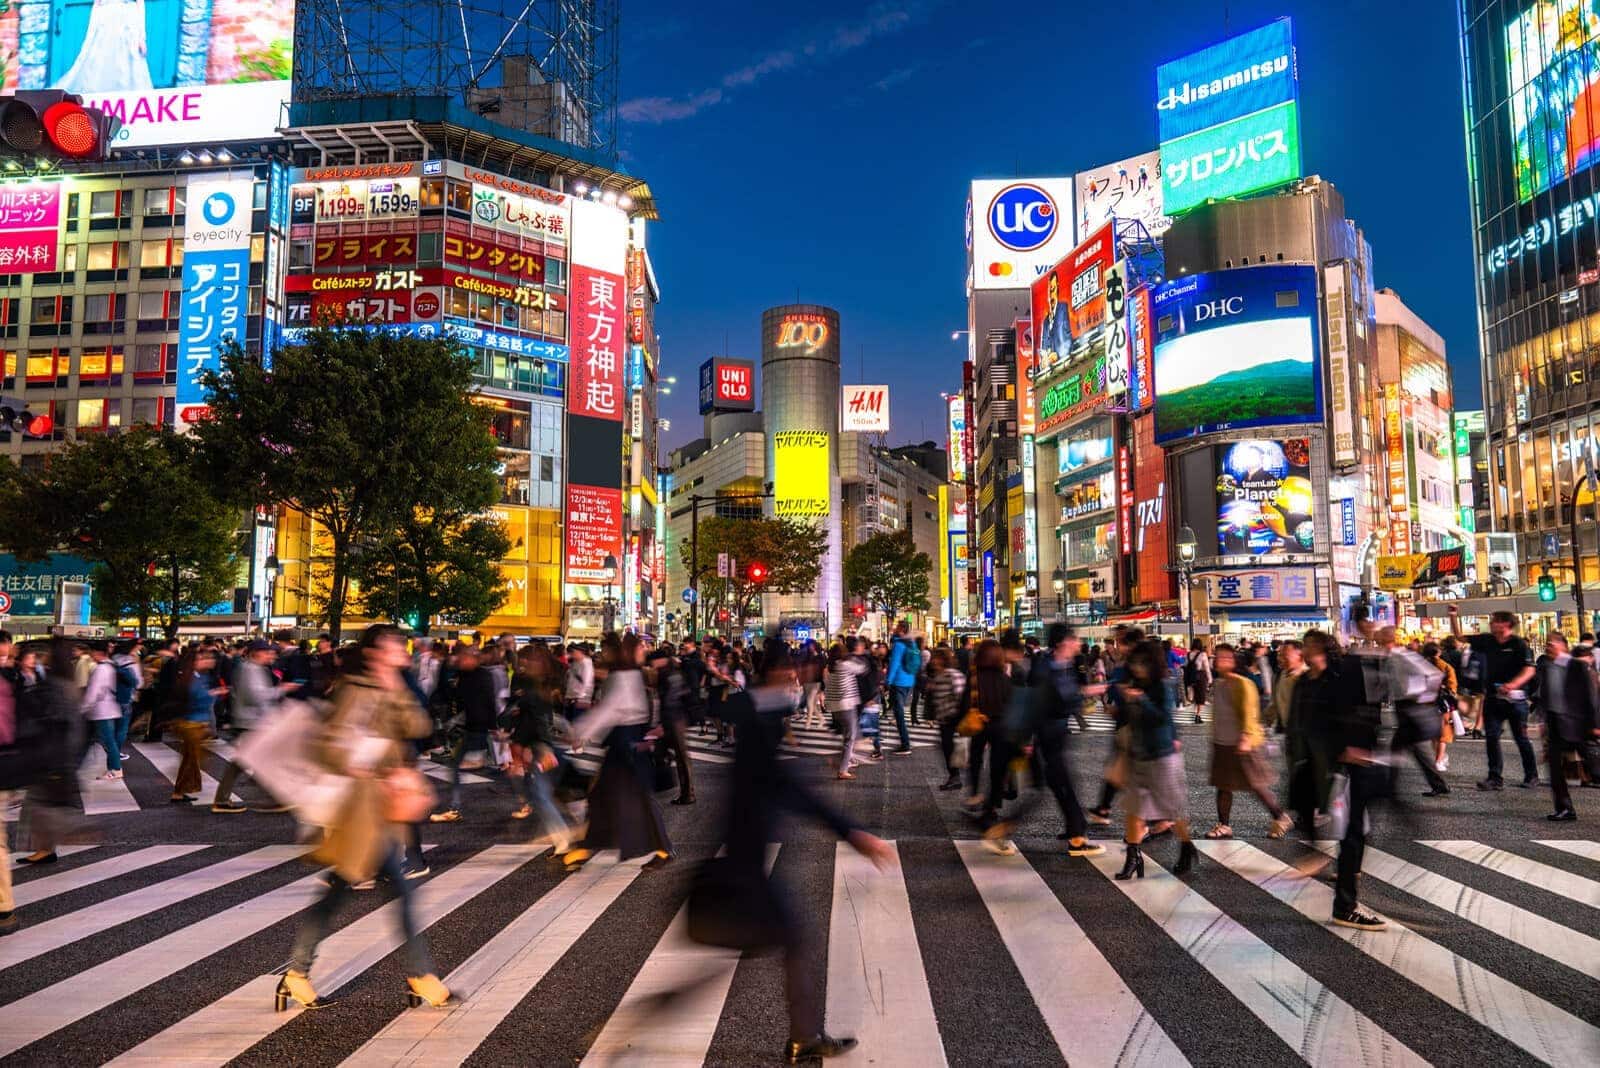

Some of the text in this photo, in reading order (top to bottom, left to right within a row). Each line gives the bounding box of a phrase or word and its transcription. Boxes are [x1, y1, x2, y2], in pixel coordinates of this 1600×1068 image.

[1157, 54, 1288, 110] Hisamitsu
[1166, 129, 1288, 187] サロンパス
[294, 199, 313, 212] 9F
[996, 200, 1051, 233] UC
[506, 202, 564, 235] しゃぶ葉
[192, 229, 242, 243] eyecity
[316, 240, 413, 262] プライス
[446, 236, 541, 276] コンタクト
[375, 270, 424, 290] ガスト
[513, 284, 558, 310] ガスト
[1155, 282, 1197, 303] DHC Channel
[288, 304, 311, 320] 7F
[345, 299, 405, 323] ガスト
[785, 315, 827, 323] SHIBUYA
[1195, 296, 1244, 322] DHC
[776, 321, 828, 354] 109
[1106, 269, 1128, 386] もんじゃ
[485, 332, 568, 359] 英会話イーオン
[585, 275, 617, 414] 東方神起
[721, 369, 745, 383] UNI
[721, 383, 748, 398] QLO
[850, 391, 886, 414] H&M
[1208, 575, 1308, 599] 堂書店
